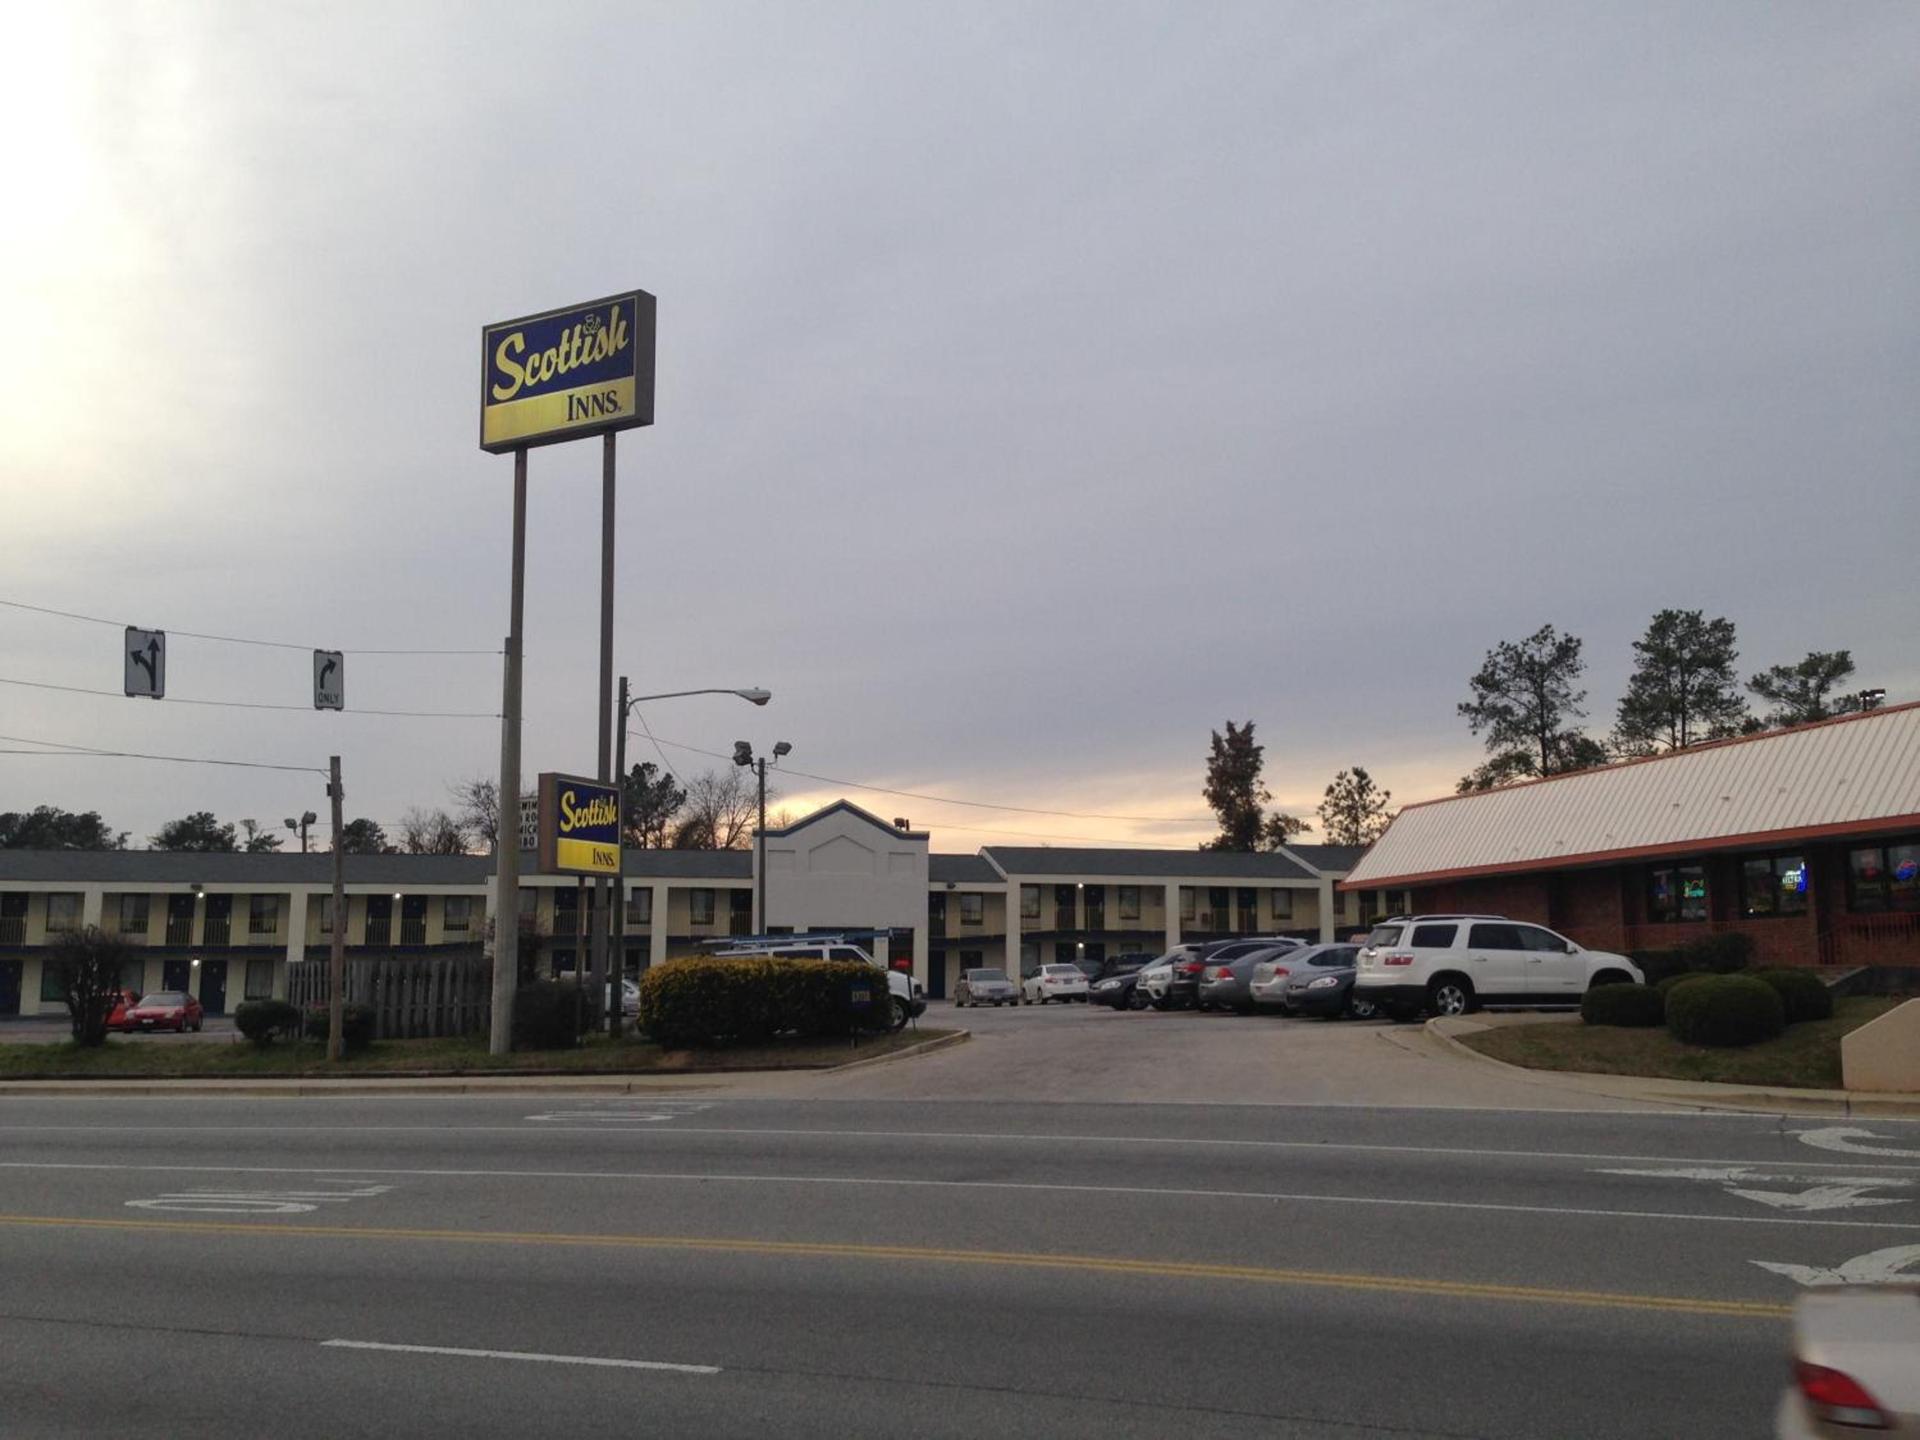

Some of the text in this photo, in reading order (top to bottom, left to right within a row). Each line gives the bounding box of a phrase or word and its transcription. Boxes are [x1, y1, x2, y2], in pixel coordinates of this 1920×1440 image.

[492, 305, 629, 401] Scottish
[318, 691, 339, 704] ONLY
[560, 791, 617, 832] Scottish
